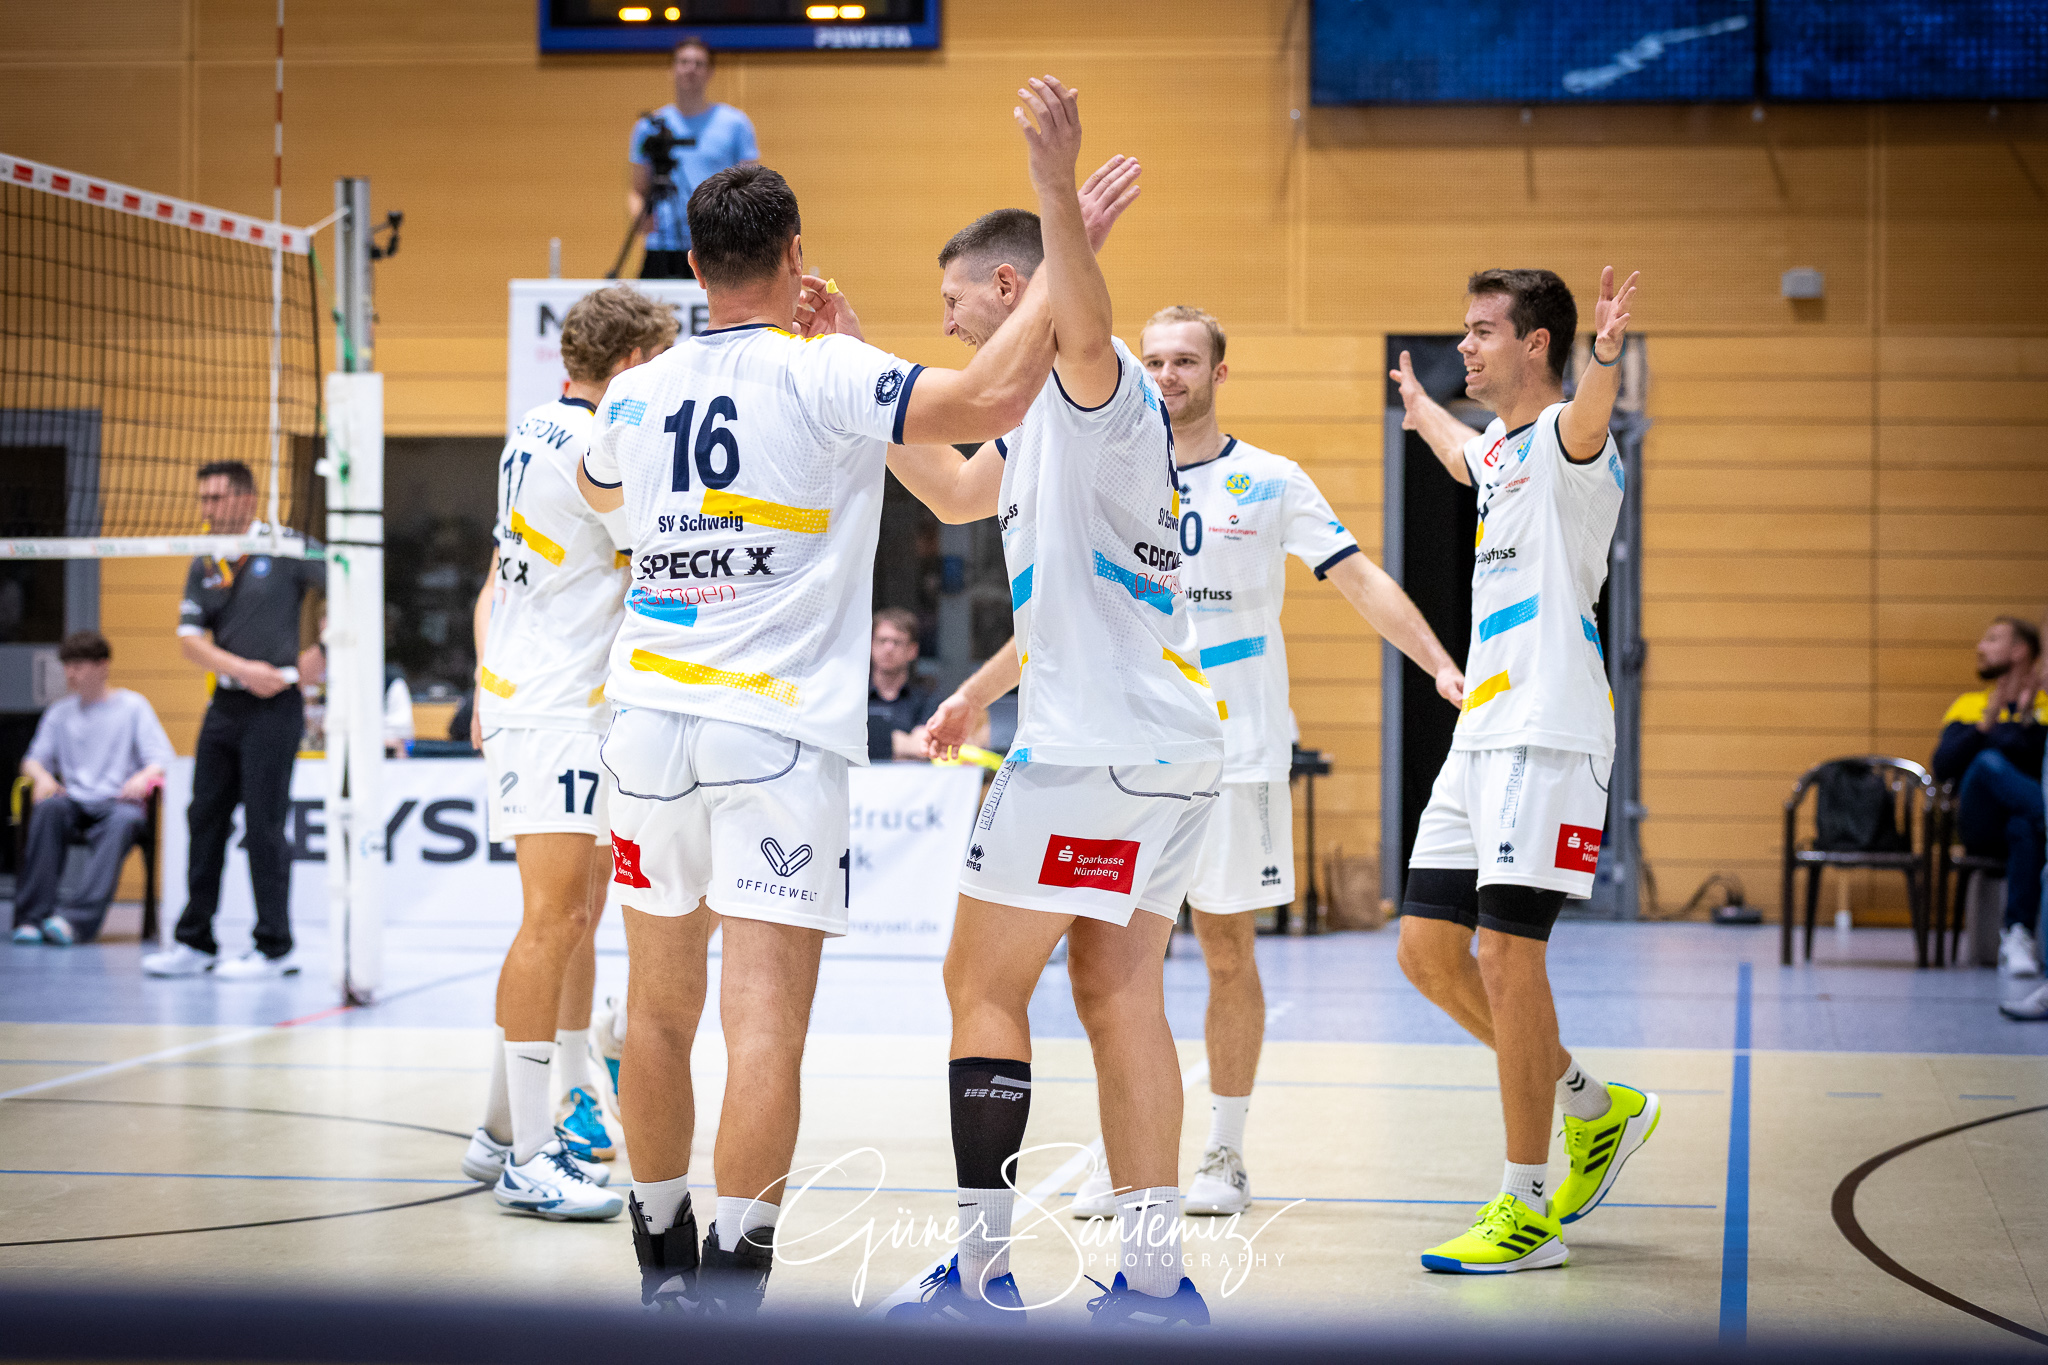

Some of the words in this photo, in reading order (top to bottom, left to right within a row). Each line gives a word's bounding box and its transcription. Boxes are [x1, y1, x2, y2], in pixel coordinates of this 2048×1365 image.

[664, 396, 740, 492] 16
[658, 515, 675, 533] SV
[679, 510, 744, 532] Schwaig
[637, 548, 735, 580] SPECK
[633, 585, 736, 611] pumpen
[558, 769, 599, 815] 17
[1077, 854, 1125, 867] Sparkasse
[1074, 866, 1119, 880] Nürnberg
[736, 878, 818, 902] OFFICEWELT
[989, 1088, 1024, 1102] cep
